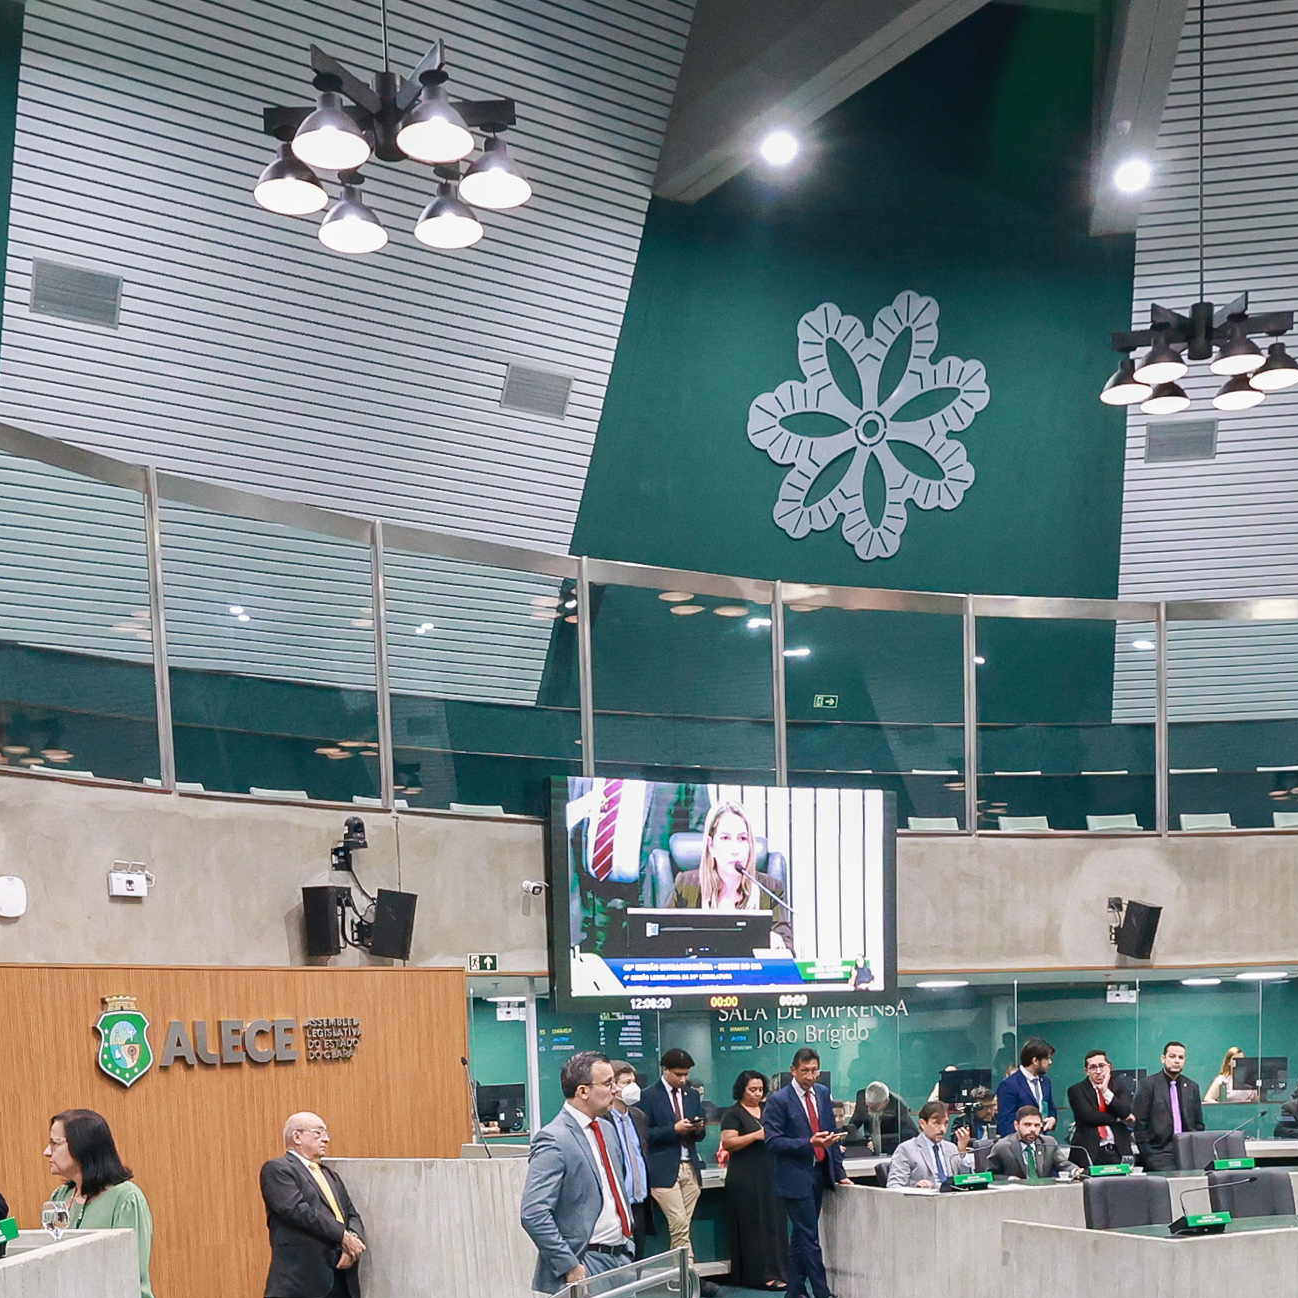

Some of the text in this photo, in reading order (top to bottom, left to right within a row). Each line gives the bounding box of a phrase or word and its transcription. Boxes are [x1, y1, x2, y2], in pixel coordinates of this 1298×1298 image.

[710, 996, 738, 1008] 00:00
[718, 1000, 909, 1022] SALA DE IMPRENSA
[306, 1028, 362, 1038] LEGISLATIVA
[756, 1027, 798, 1048] João
[805, 1022, 869, 1049] Brígido
[159, 1018, 299, 1067] ALECE
[308, 1038, 359, 1048] DO ESTADO
[309, 1050, 321, 1059] DO
